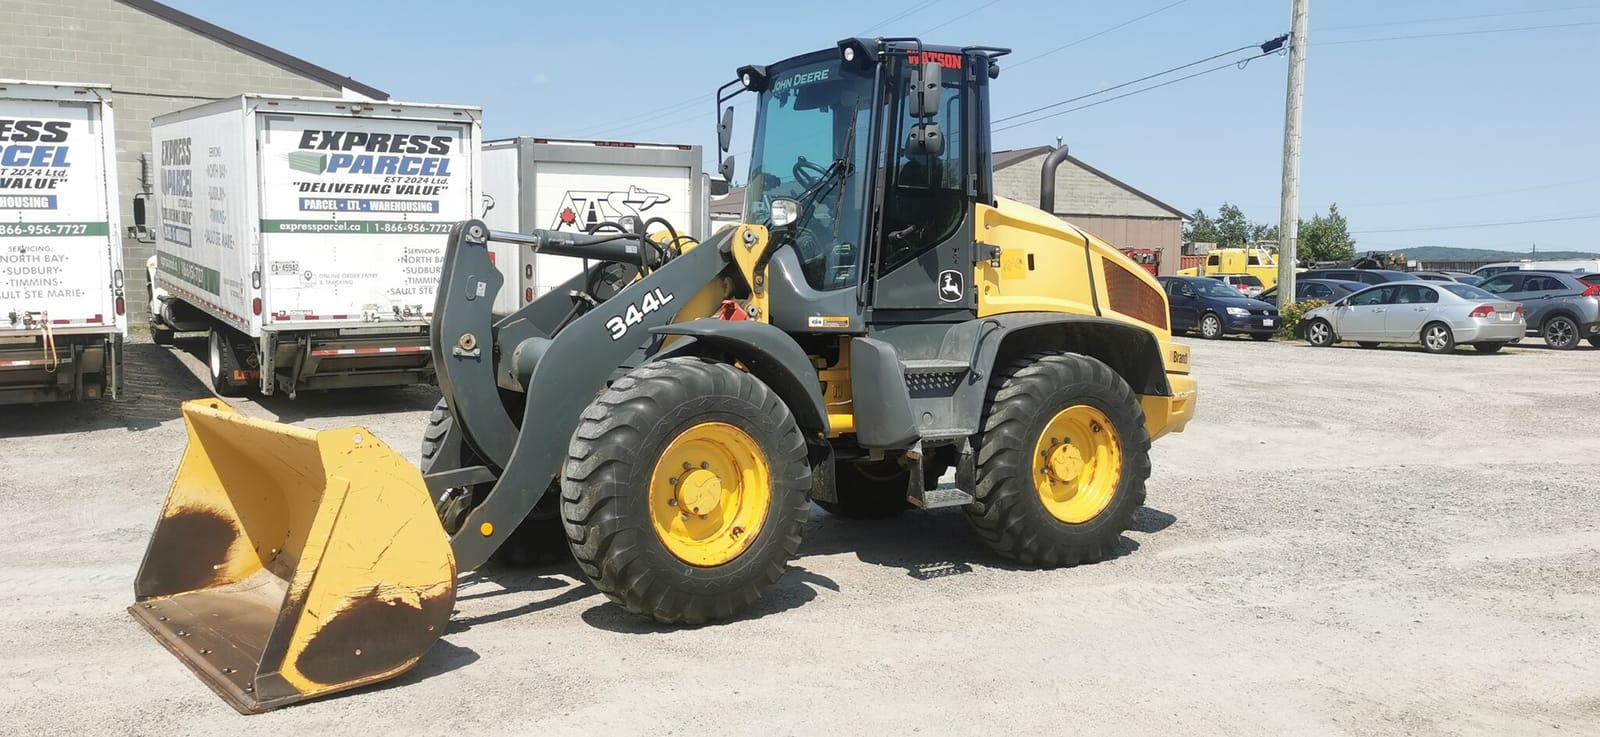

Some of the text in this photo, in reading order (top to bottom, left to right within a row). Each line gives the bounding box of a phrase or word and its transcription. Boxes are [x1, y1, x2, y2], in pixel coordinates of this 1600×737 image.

[907, 50, 962, 69] WATSON
[772, 69, 830, 93] JOHN DEERE
[161, 137, 191, 166] EXPRESS
[298, 130, 453, 155] EXPRESS
[0, 145, 72, 167] CEL
[327, 153, 452, 176] PARCEL
[10, 168, 42, 176] 2024
[45, 169, 68, 177] Ltd.
[167, 169, 192, 197] PARCEL
[384, 176, 449, 185] EST 2024 Ltd.
[304, 199, 433, 212] PARCEL LTL WAREHOUSING
[280, 222, 453, 233] expressparcel.ca 1-866-956-7727
[24, 290, 43, 299] STE
[605, 287, 675, 341] 344L
